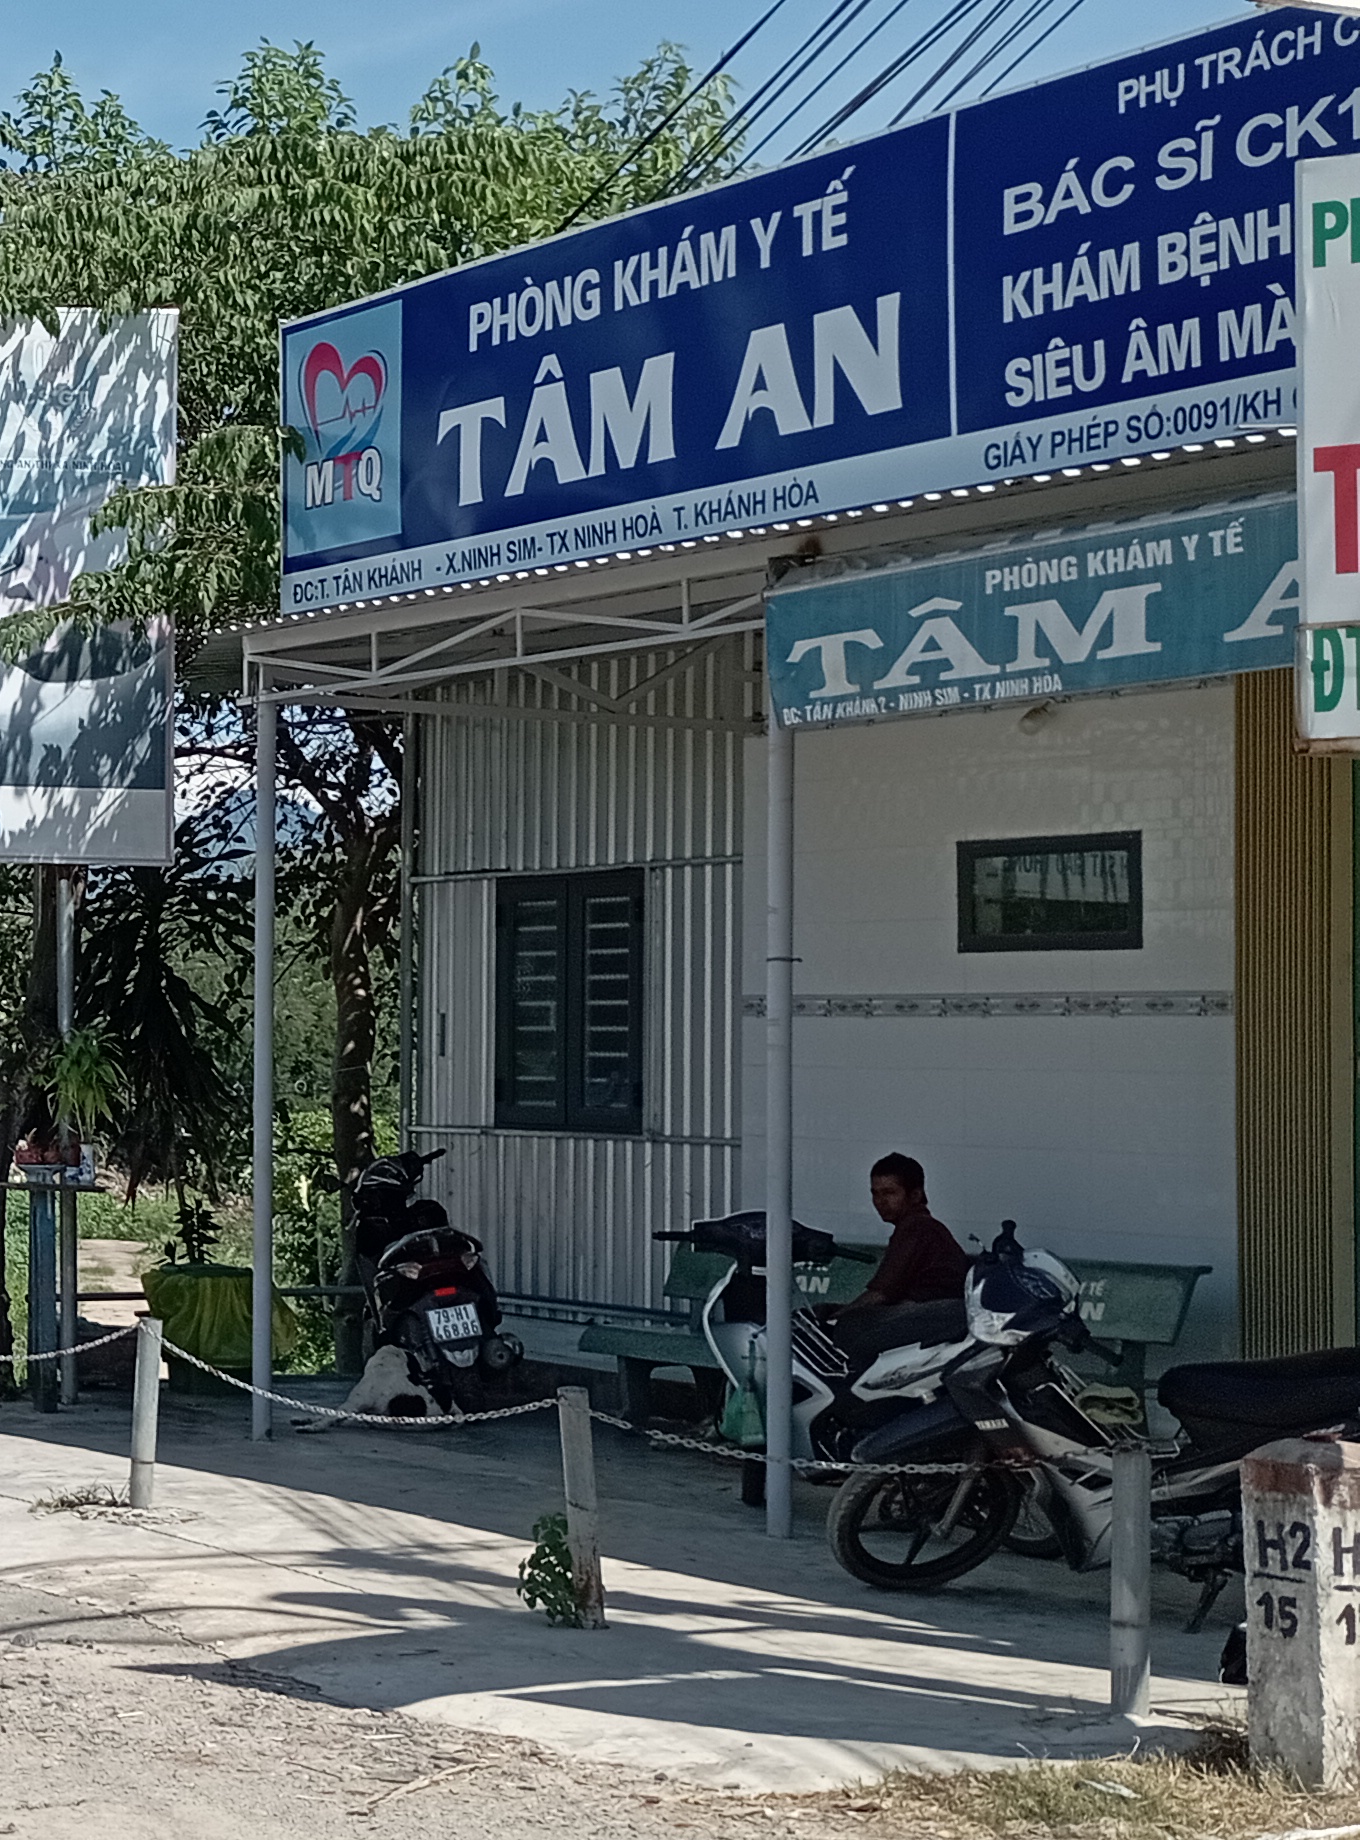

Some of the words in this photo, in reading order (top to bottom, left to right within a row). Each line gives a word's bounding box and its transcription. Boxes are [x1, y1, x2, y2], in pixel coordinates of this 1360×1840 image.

[1118, 63, 1185, 114] PHỤ
[1194, 20, 1321, 89] TRÁCH
[1003, 156, 1135, 235] BÁC
[1155, 114, 1221, 191] SĨ
[469, 269, 601, 352] PHÒNG
[614, 225, 736, 311] KHÁM
[750, 211, 781, 268] Y
[793, 165, 856, 257] TẾ
[1002, 241, 1141, 324] KHÁM
[1157, 203, 1291, 287] BỆNH
[436, 352, 676, 506] TÂM
[715, 291, 902, 451] AN
[1004, 337, 1106, 407] SIÊU
[1121, 317, 1201, 383] ÂM
[304, 446, 382, 510] MTQ
[984, 430, 1043, 471] GIẤY
[1050, 415, 1119, 459] PHÉP
[333, 568, 363, 597] TÂN
[367, 558, 422, 589] KHÁNH
[546, 530, 570, 557] TX
[574, 520, 617, 550] NINH
[621, 505, 663, 541] HOÀ
[673, 506, 688, 531] T.
[693, 490, 766, 527] KHÁNH
[772, 477, 820, 511] HÒA
[985, 556, 1078, 594] PHÒNG
[1087, 537, 1173, 577] KHÁM
[1181, 534, 1200, 560] Y
[1208, 518, 1245, 555] TẾ
[786, 583, 1162, 699] TÂM
[805, 701, 833, 721] TÂN
[898, 691, 931, 711] NINH
[936, 686, 961, 708] SIM
[974, 684, 992, 702] TX
[995, 679, 1029, 700] NINH
[1032, 671, 1063, 694] HÒA
[1256, 1520, 1311, 1571] H2
[1256, 1591, 1298, 1639] 15
